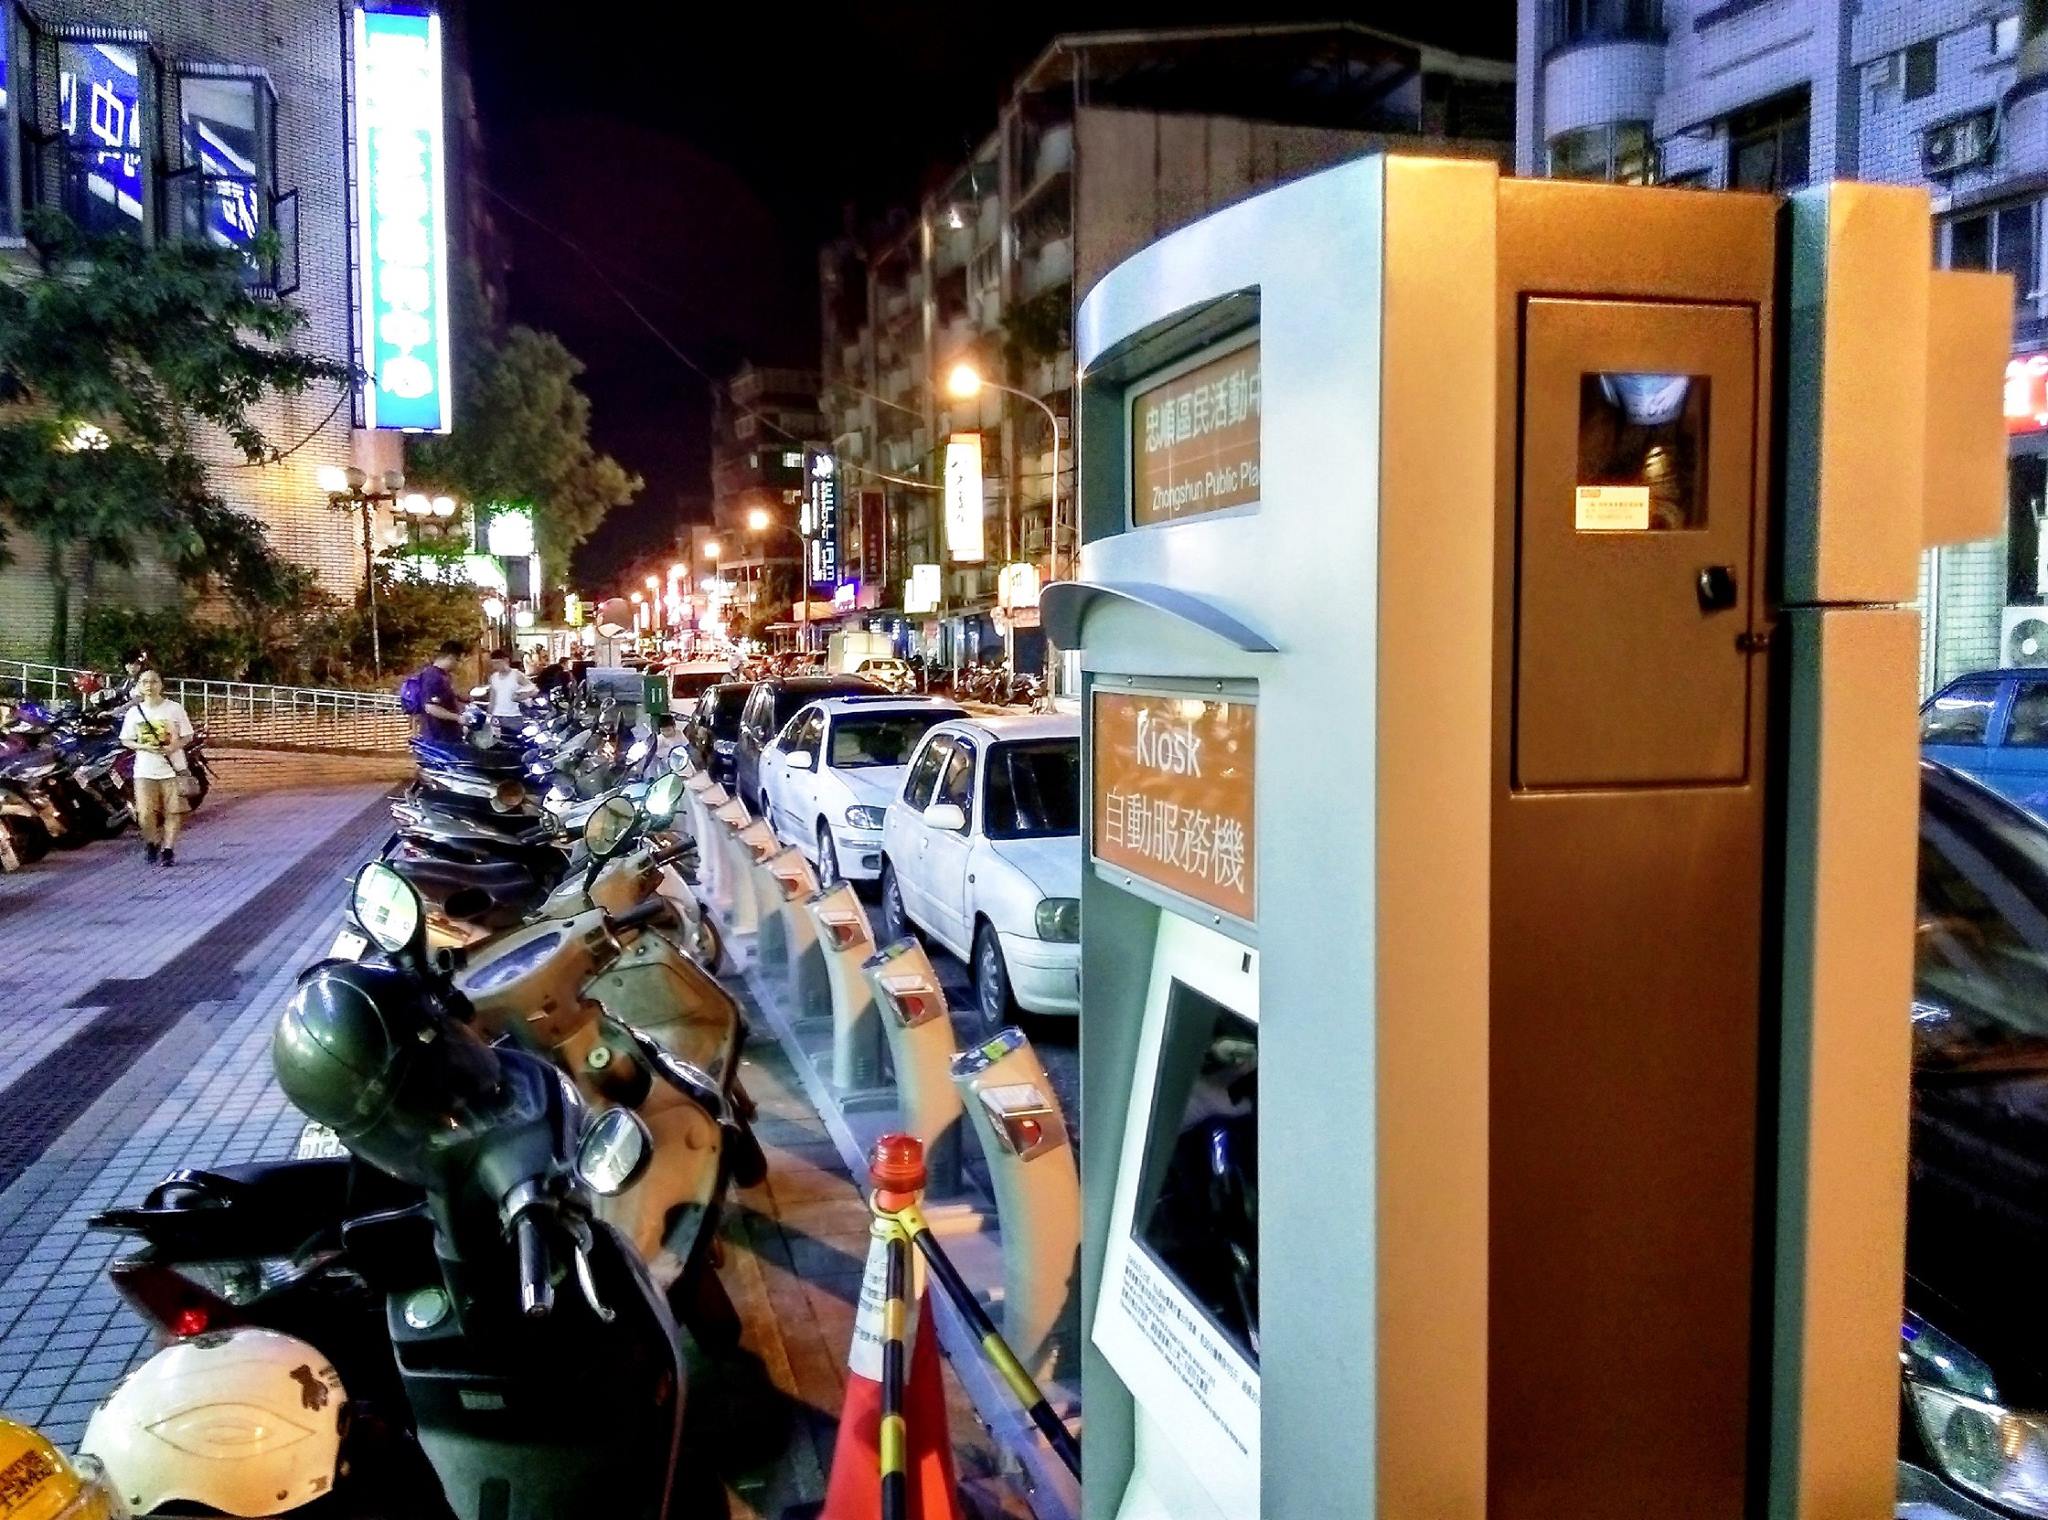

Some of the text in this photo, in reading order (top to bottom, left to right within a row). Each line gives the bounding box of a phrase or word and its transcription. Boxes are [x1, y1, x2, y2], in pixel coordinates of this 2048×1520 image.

[1152, 477, 1203, 511] Zhongshun
[1205, 464, 1238, 498] Public
[1136, 708, 1202, 778] Kiosk
[1105, 785, 1246, 895] 自動服務機
